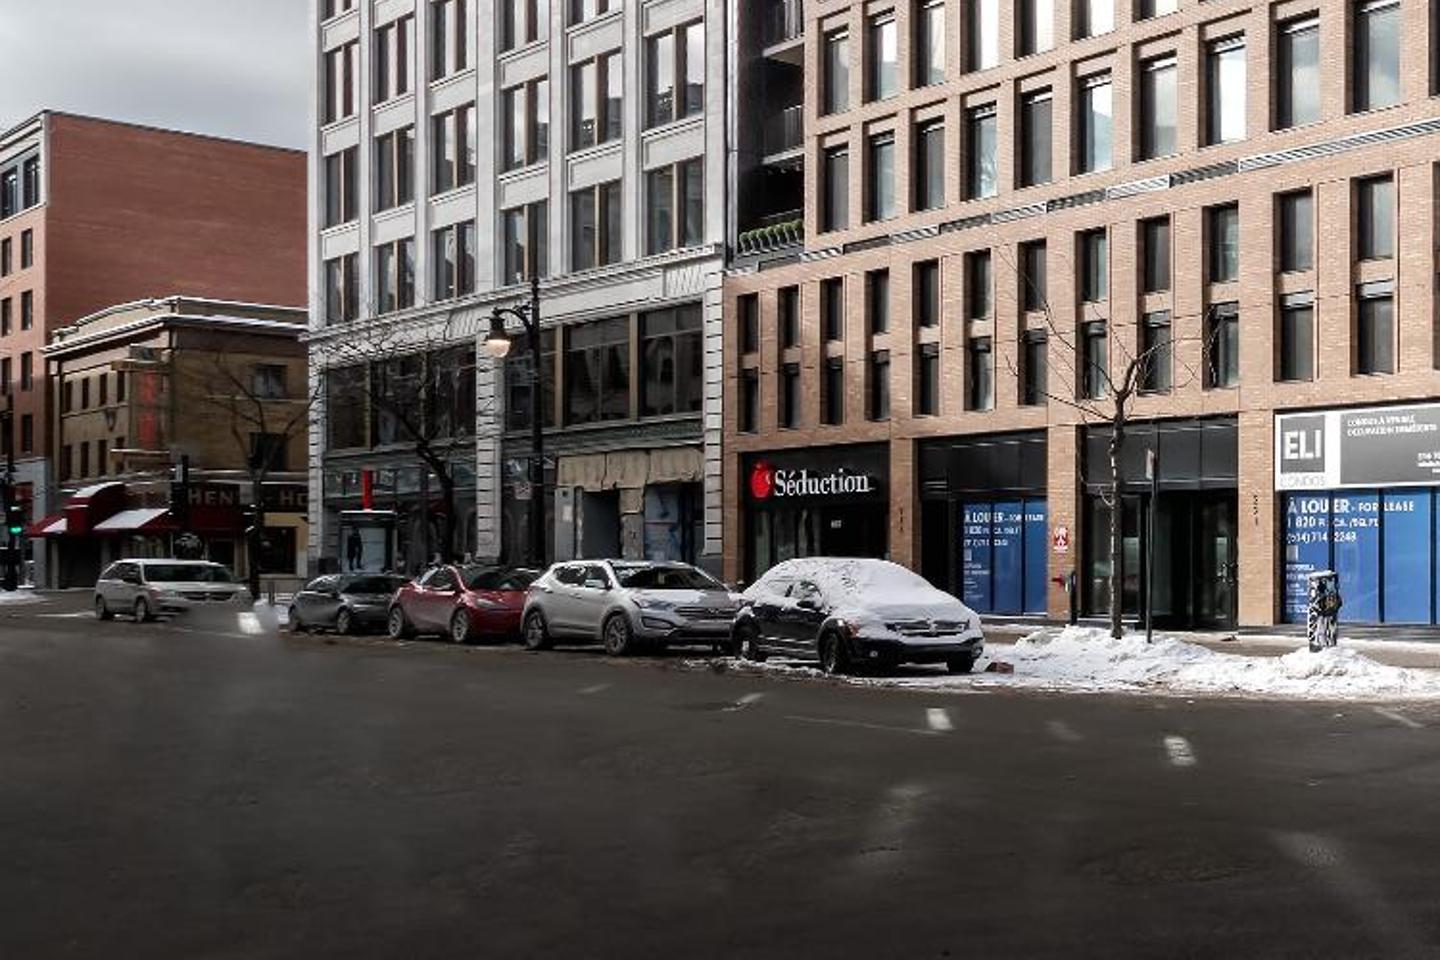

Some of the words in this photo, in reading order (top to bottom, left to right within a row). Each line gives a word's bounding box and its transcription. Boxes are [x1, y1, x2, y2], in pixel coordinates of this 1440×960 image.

[1284, 430, 1323, 461] ELI
[774, 468, 870, 496] Séduction
[1301, 499, 1350, 514] LOUER
